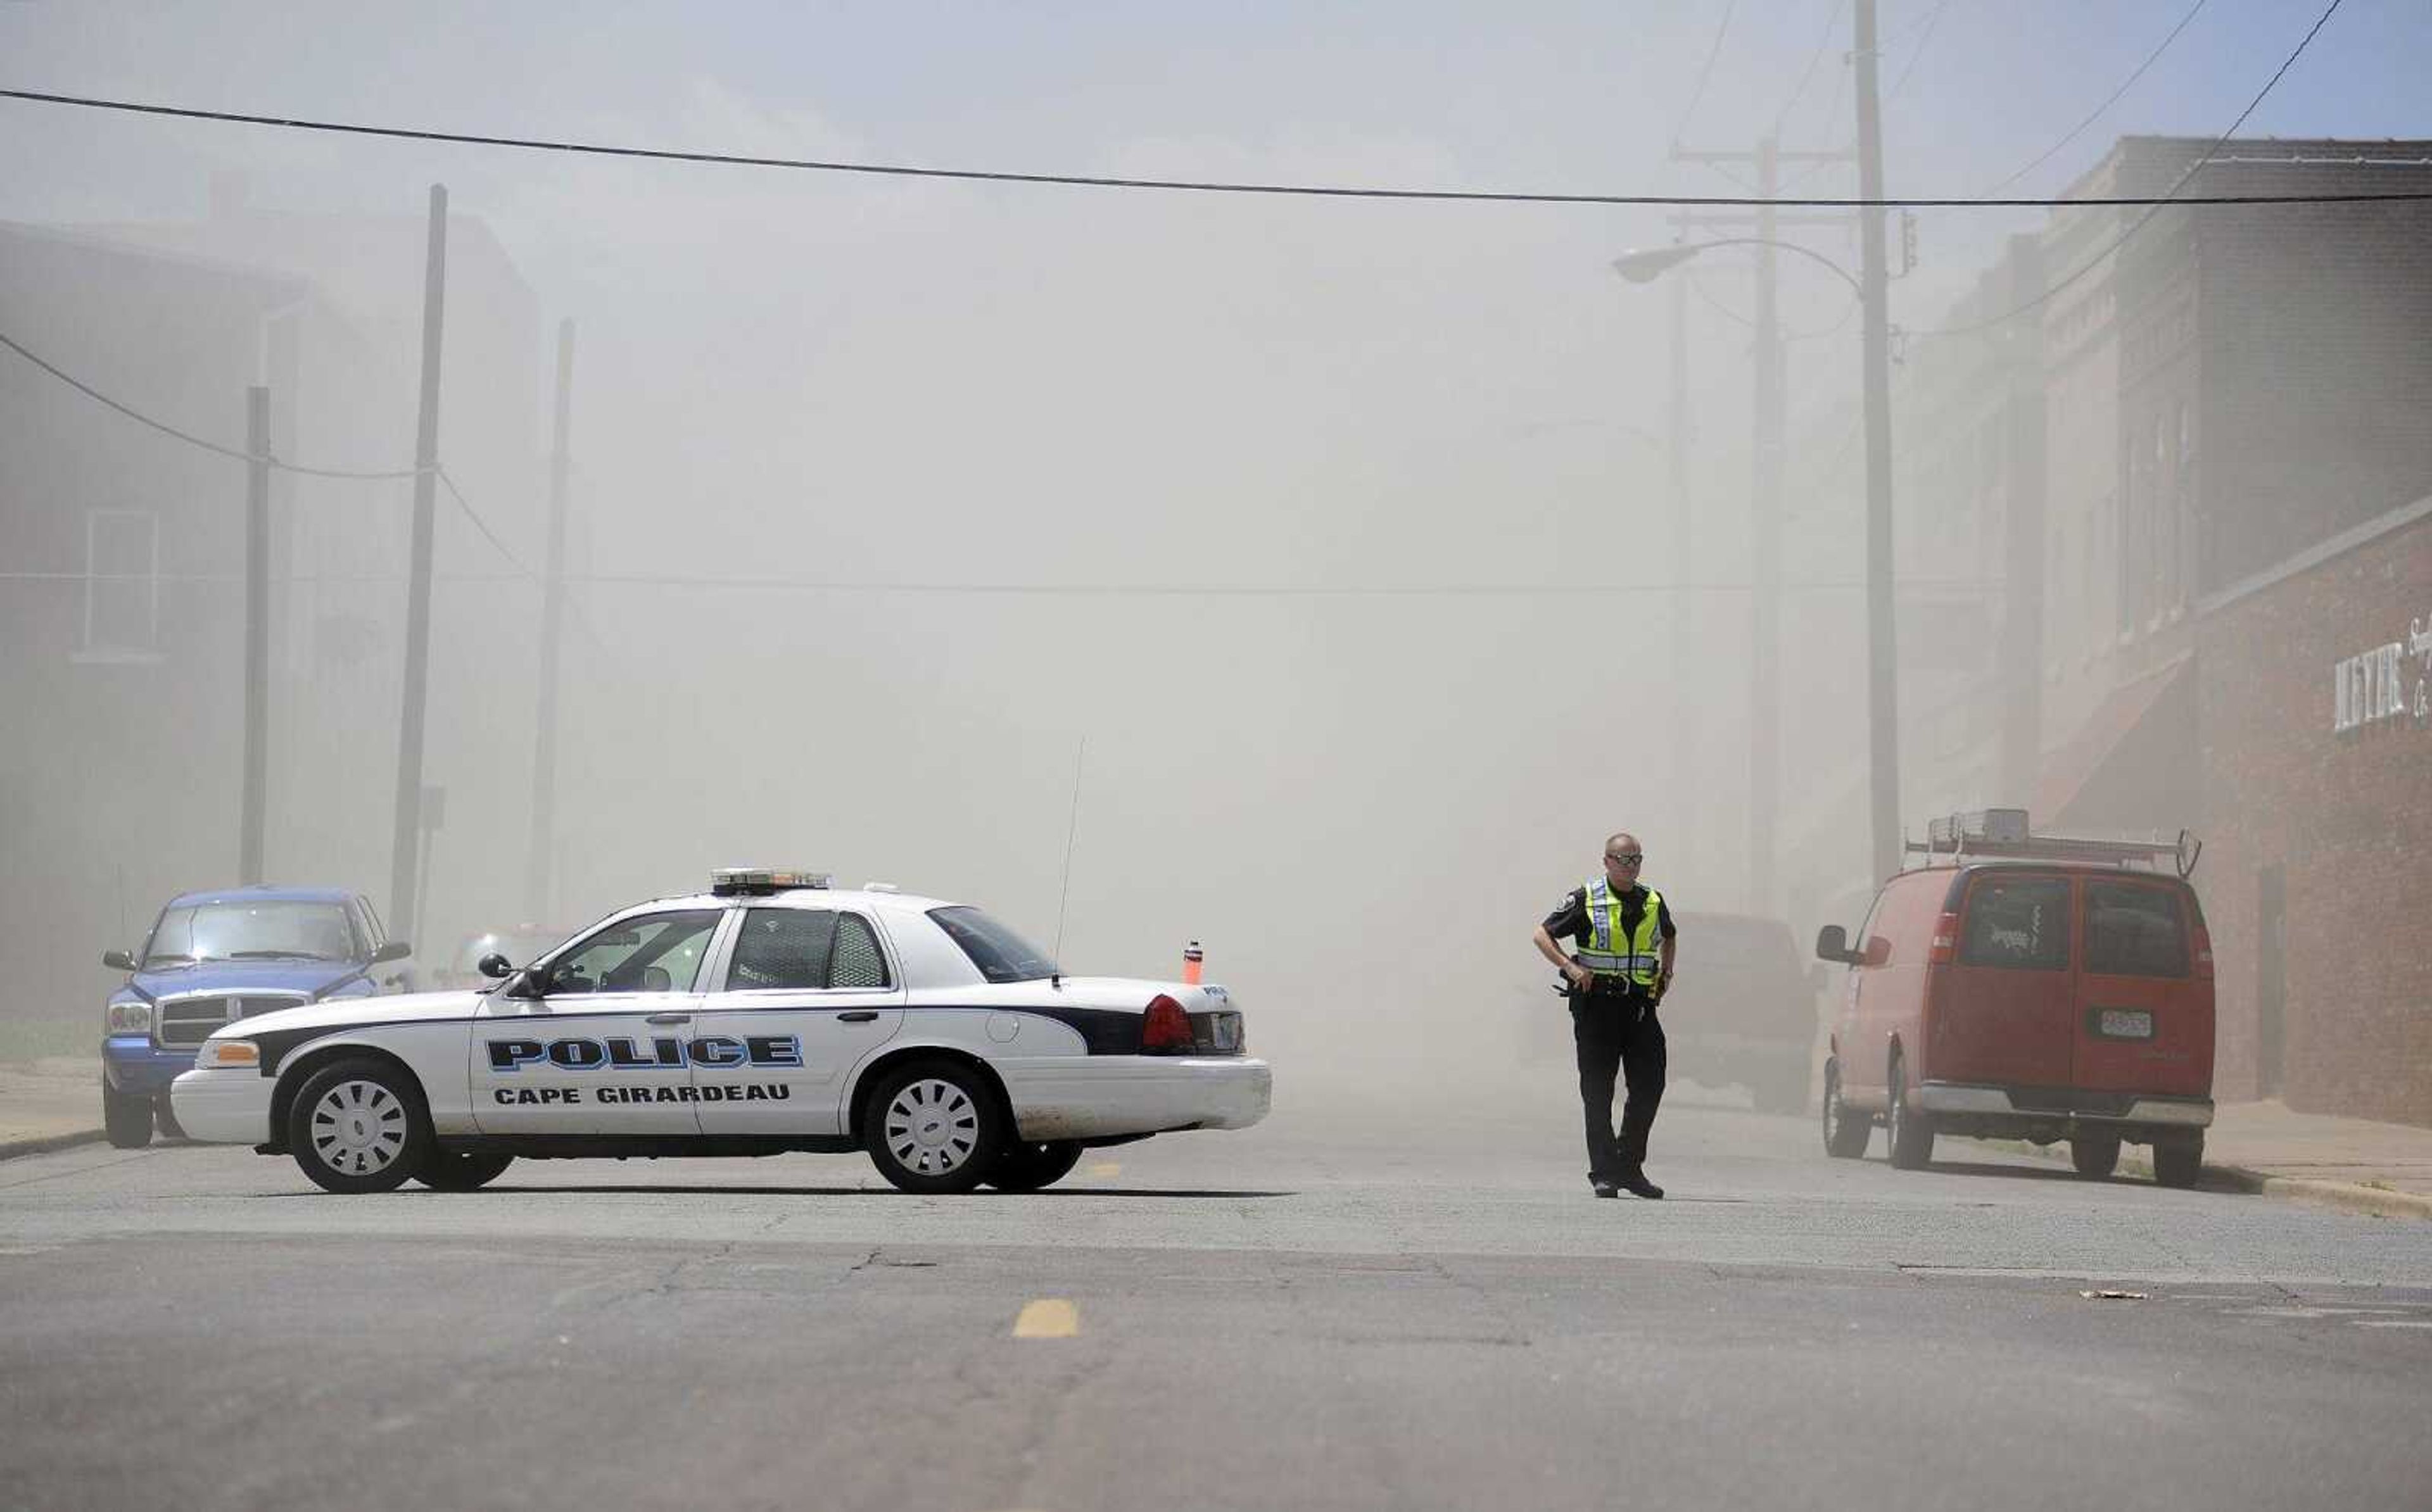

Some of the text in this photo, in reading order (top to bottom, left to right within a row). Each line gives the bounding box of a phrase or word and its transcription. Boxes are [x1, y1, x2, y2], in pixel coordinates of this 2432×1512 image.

[487, 1035, 804, 1071] POLICE
[495, 1083, 790, 1104] CAPE GIRARDEAU
